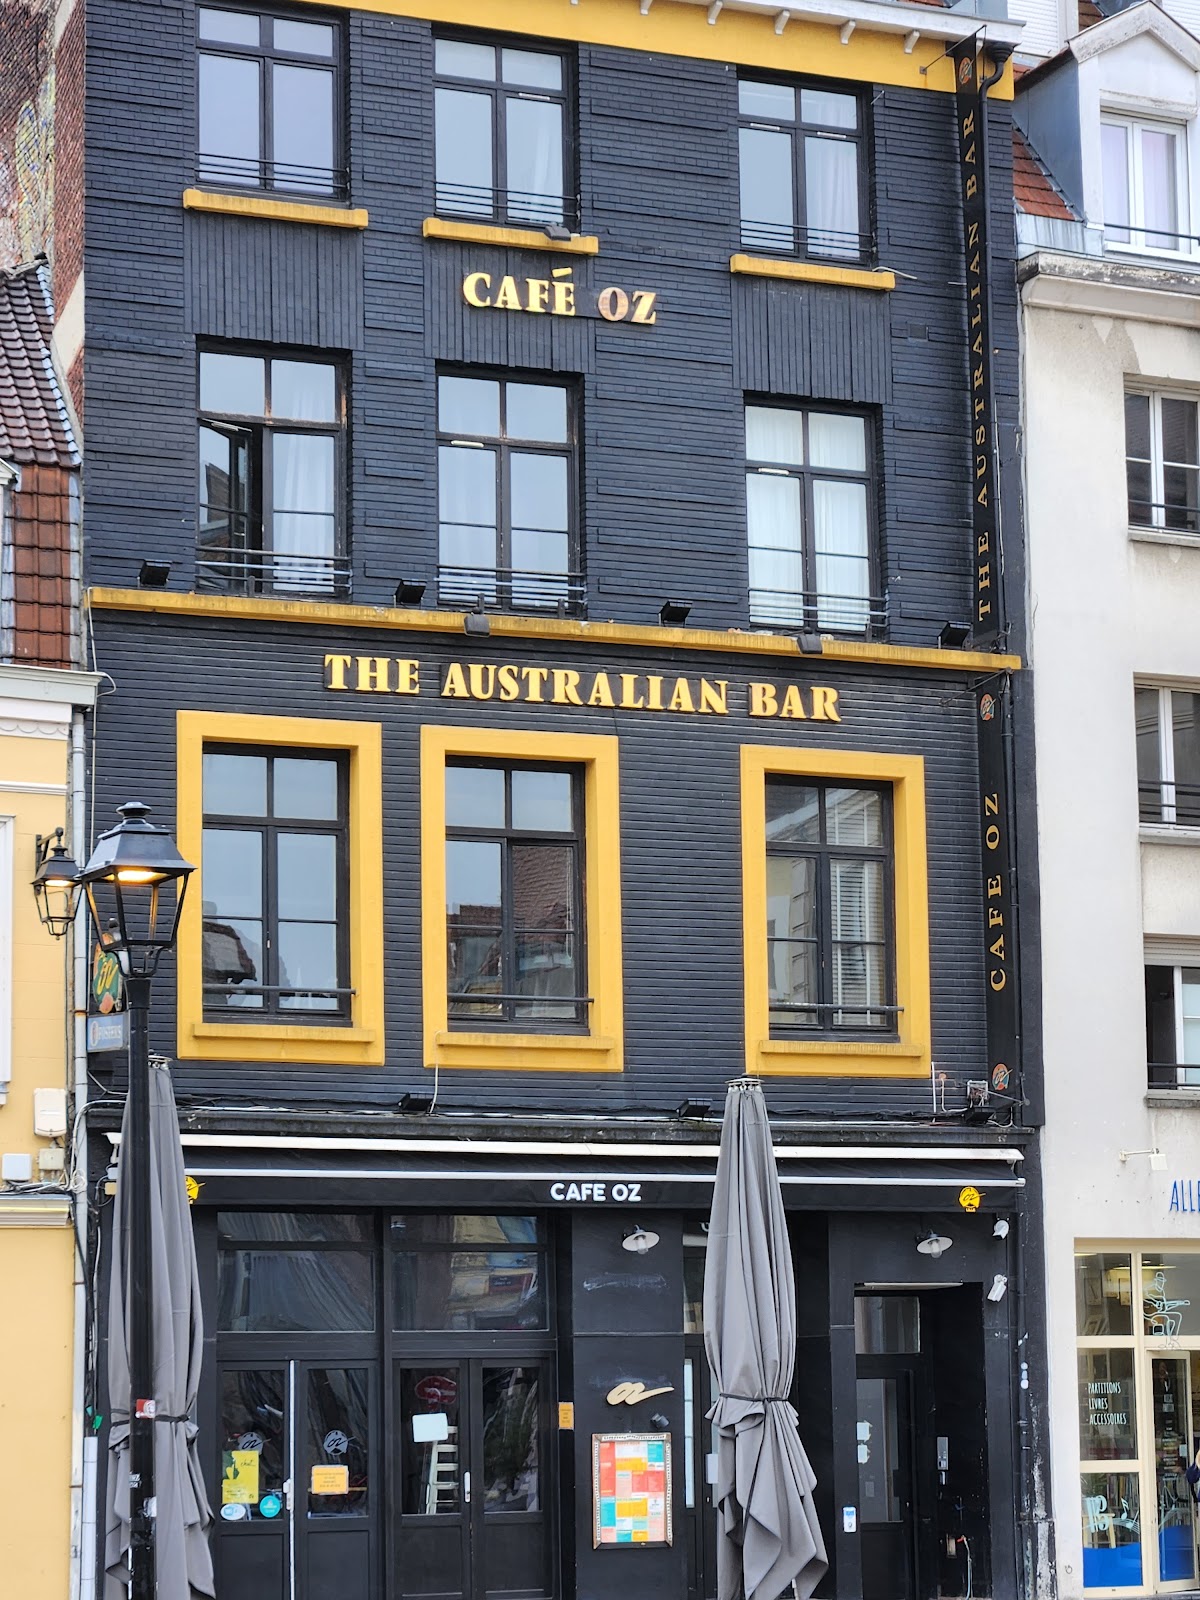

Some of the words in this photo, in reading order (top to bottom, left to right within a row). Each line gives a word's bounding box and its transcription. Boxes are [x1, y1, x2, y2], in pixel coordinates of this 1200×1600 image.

[961, 108, 979, 199] BAR
[462, 267, 576, 316] CAFÉ
[598, 286, 657, 325] OZ
[966, 222, 989, 508] AUSTRALIAN
[977, 531, 991, 622] THE
[324, 654, 420, 694] THE
[440, 662, 729, 714] AUSTRALIAN
[748, 682, 842, 722] BAR
[984, 791, 1000, 850] OZ
[987, 874, 1007, 992] CAFE
[550, 1183, 606, 1202] CAFE
[611, 1183, 642, 1202] OZ
[1087, 1382, 1122, 1395] PARTITIONS
[1088, 1397, 1109, 1410] LIVRES
[1089, 1413, 1127, 1426] ACCESSOIRES
